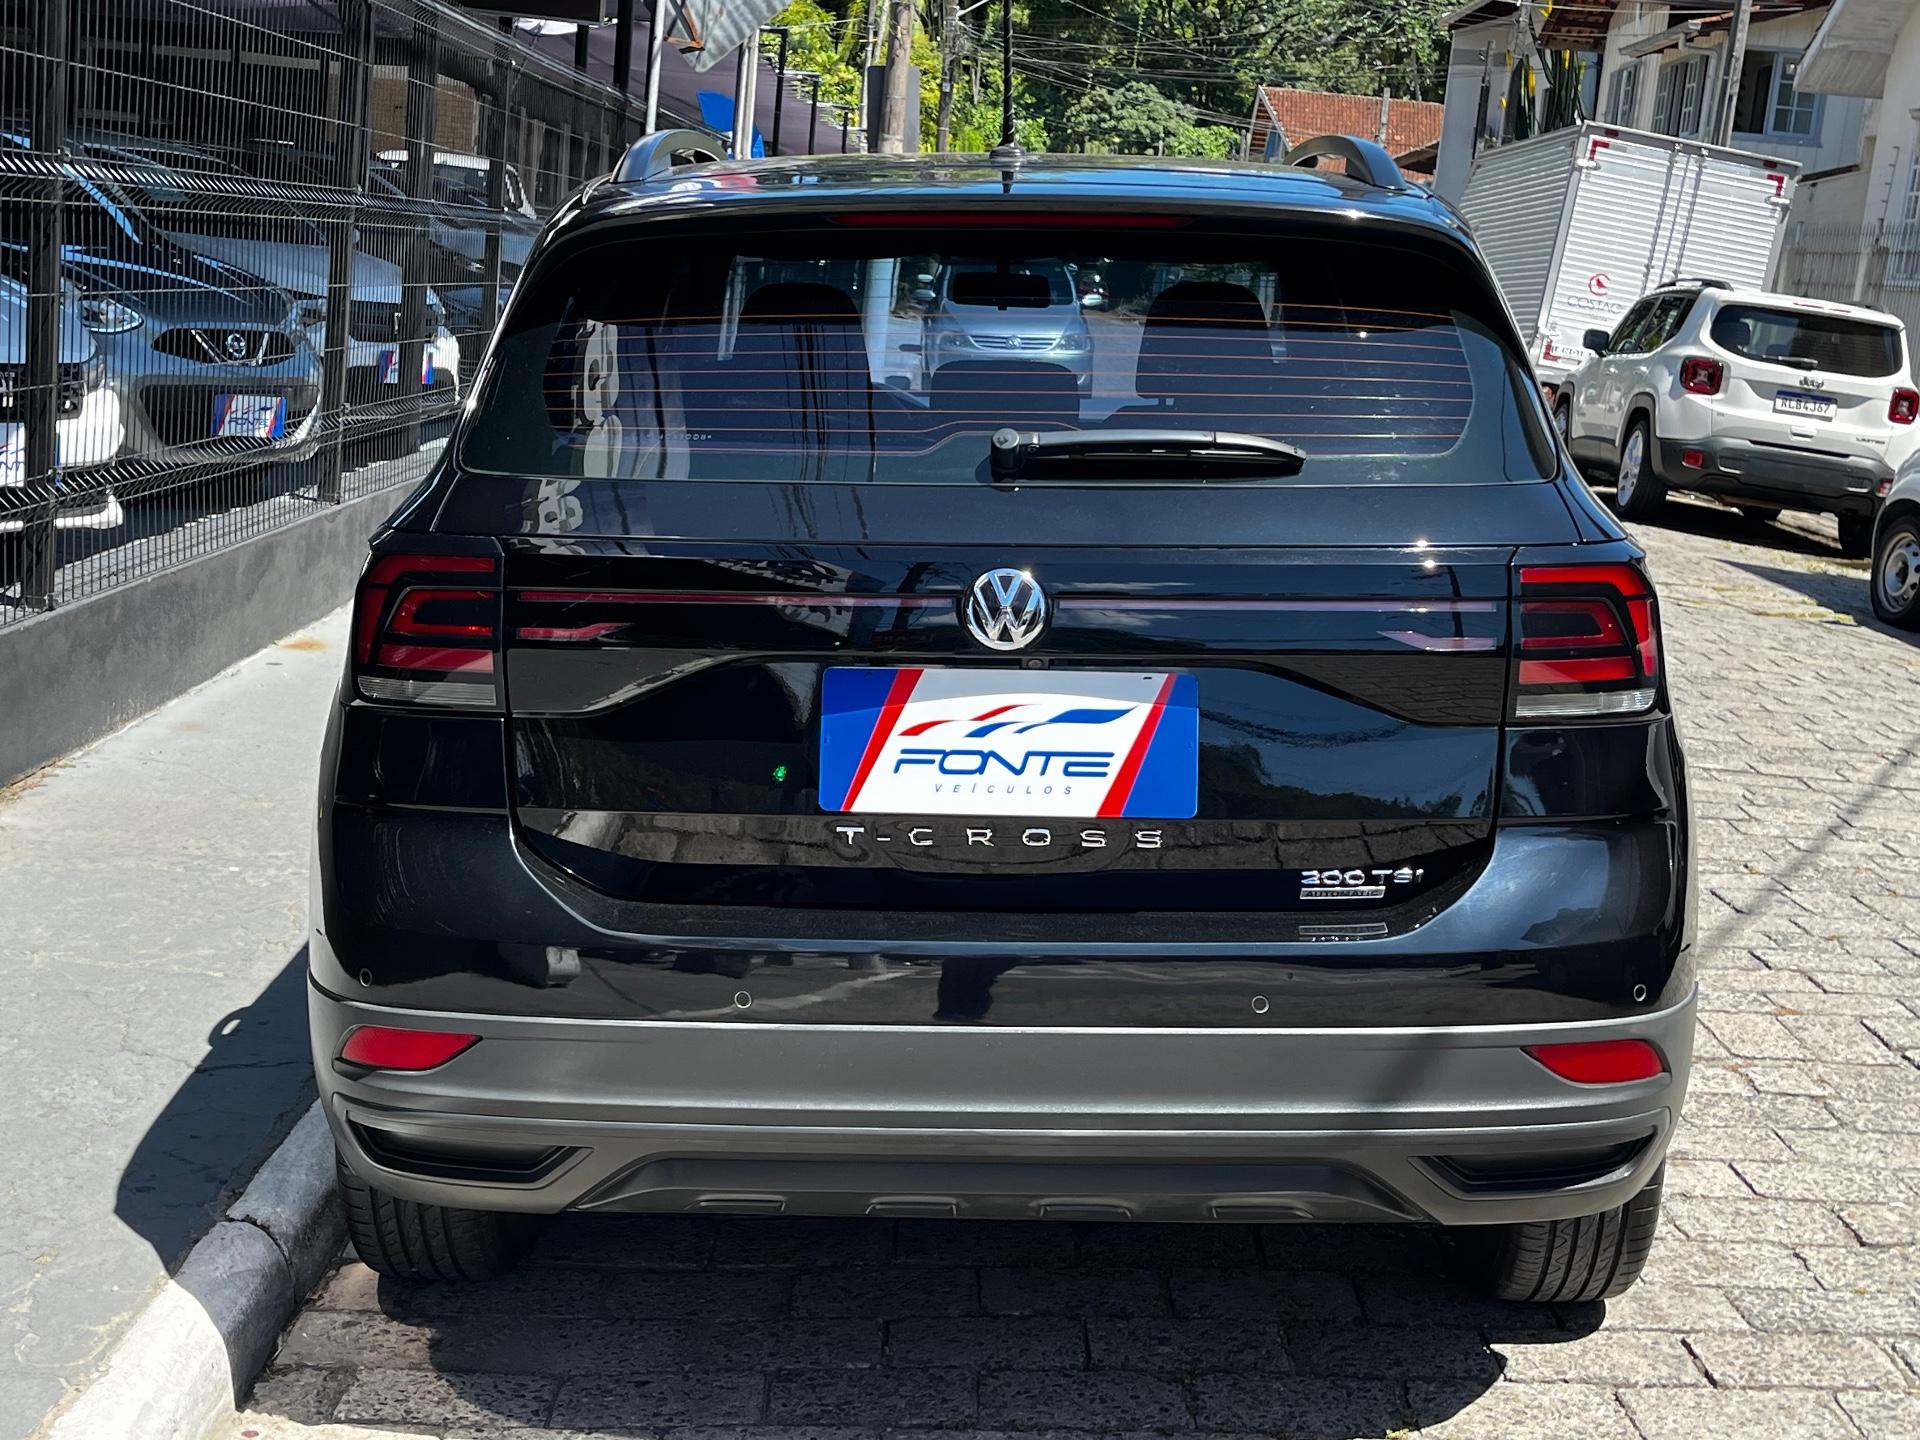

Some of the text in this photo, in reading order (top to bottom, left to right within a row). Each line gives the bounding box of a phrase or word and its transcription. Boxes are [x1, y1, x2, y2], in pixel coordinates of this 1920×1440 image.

[893, 747, 1116, 778] FONTE
[934, 782, 1073, 796] VEÍCULOS
[835, 826, 1164, 848] T-CROSS
[1301, 868, 1365, 885] 200
